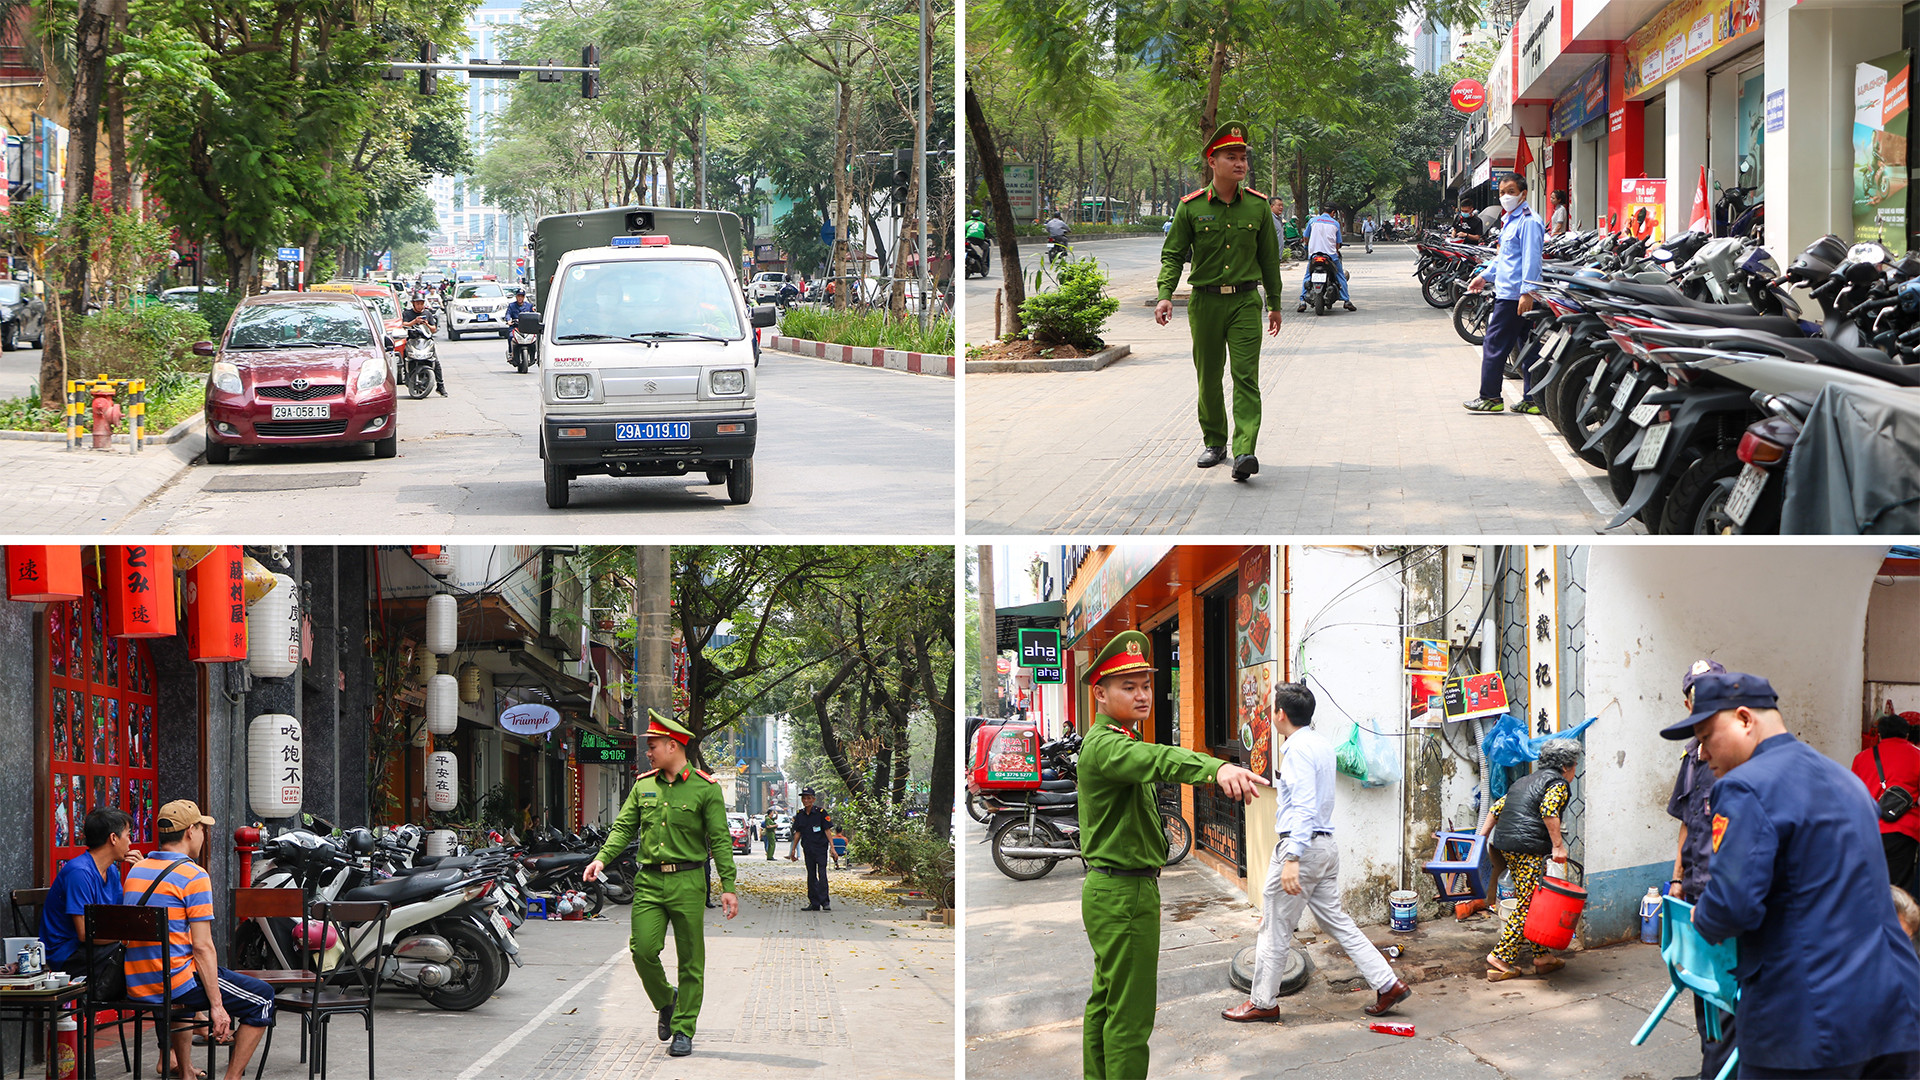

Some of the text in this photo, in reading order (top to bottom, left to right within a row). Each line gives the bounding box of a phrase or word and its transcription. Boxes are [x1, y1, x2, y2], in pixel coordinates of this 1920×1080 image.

[274, 406, 328, 418] 29A-058.15
[617, 423, 688, 439] 29A-019.10
[1024, 640, 1056, 657] aha
[1037, 668, 1060, 677] aha
[503, 711, 551, 729] Triumph
[280, 724, 301, 784] 吃饱不
[1022, 739, 1030, 753] 1
[435, 755, 450, 791] 平安在
